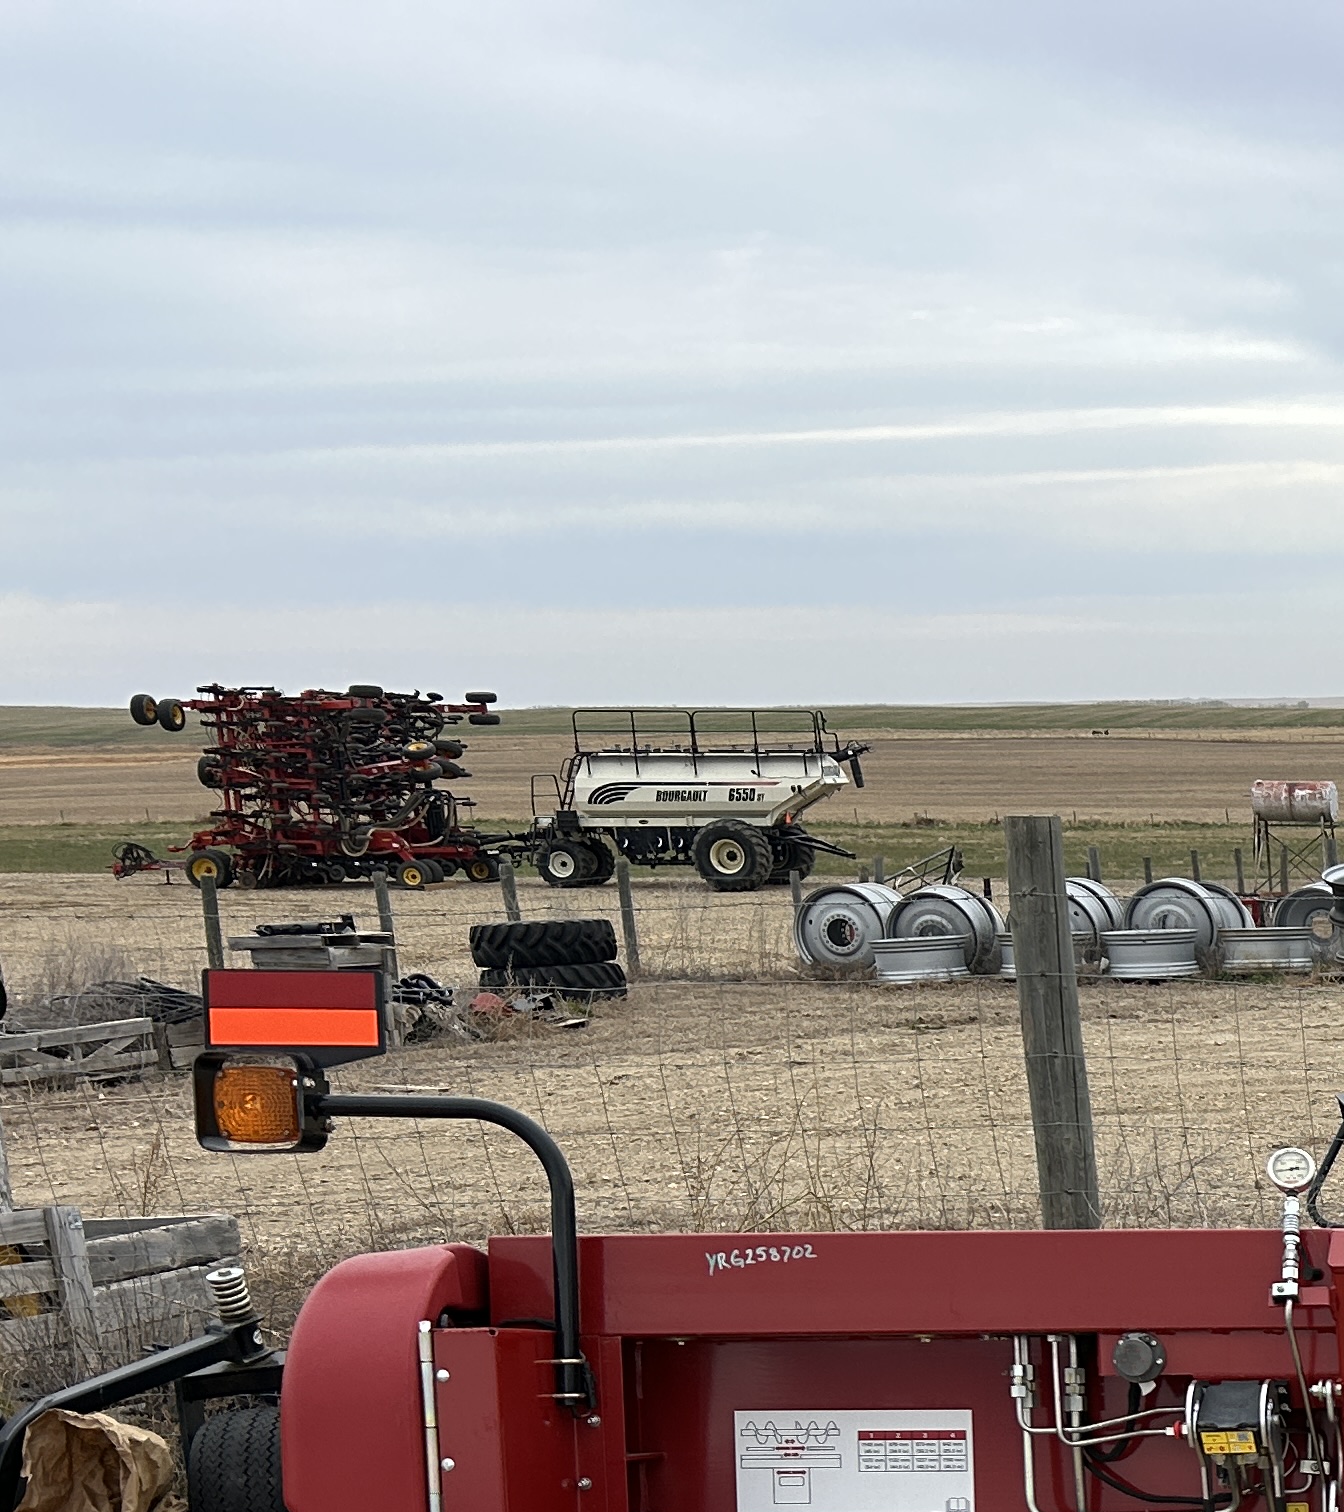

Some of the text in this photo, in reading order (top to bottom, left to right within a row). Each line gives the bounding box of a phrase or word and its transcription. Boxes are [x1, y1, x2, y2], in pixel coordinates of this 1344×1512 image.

[655, 790, 709, 802] BOURGAULT
[728, 788, 756, 802] 6550
[705, 1243, 818, 1276] YRG258702
